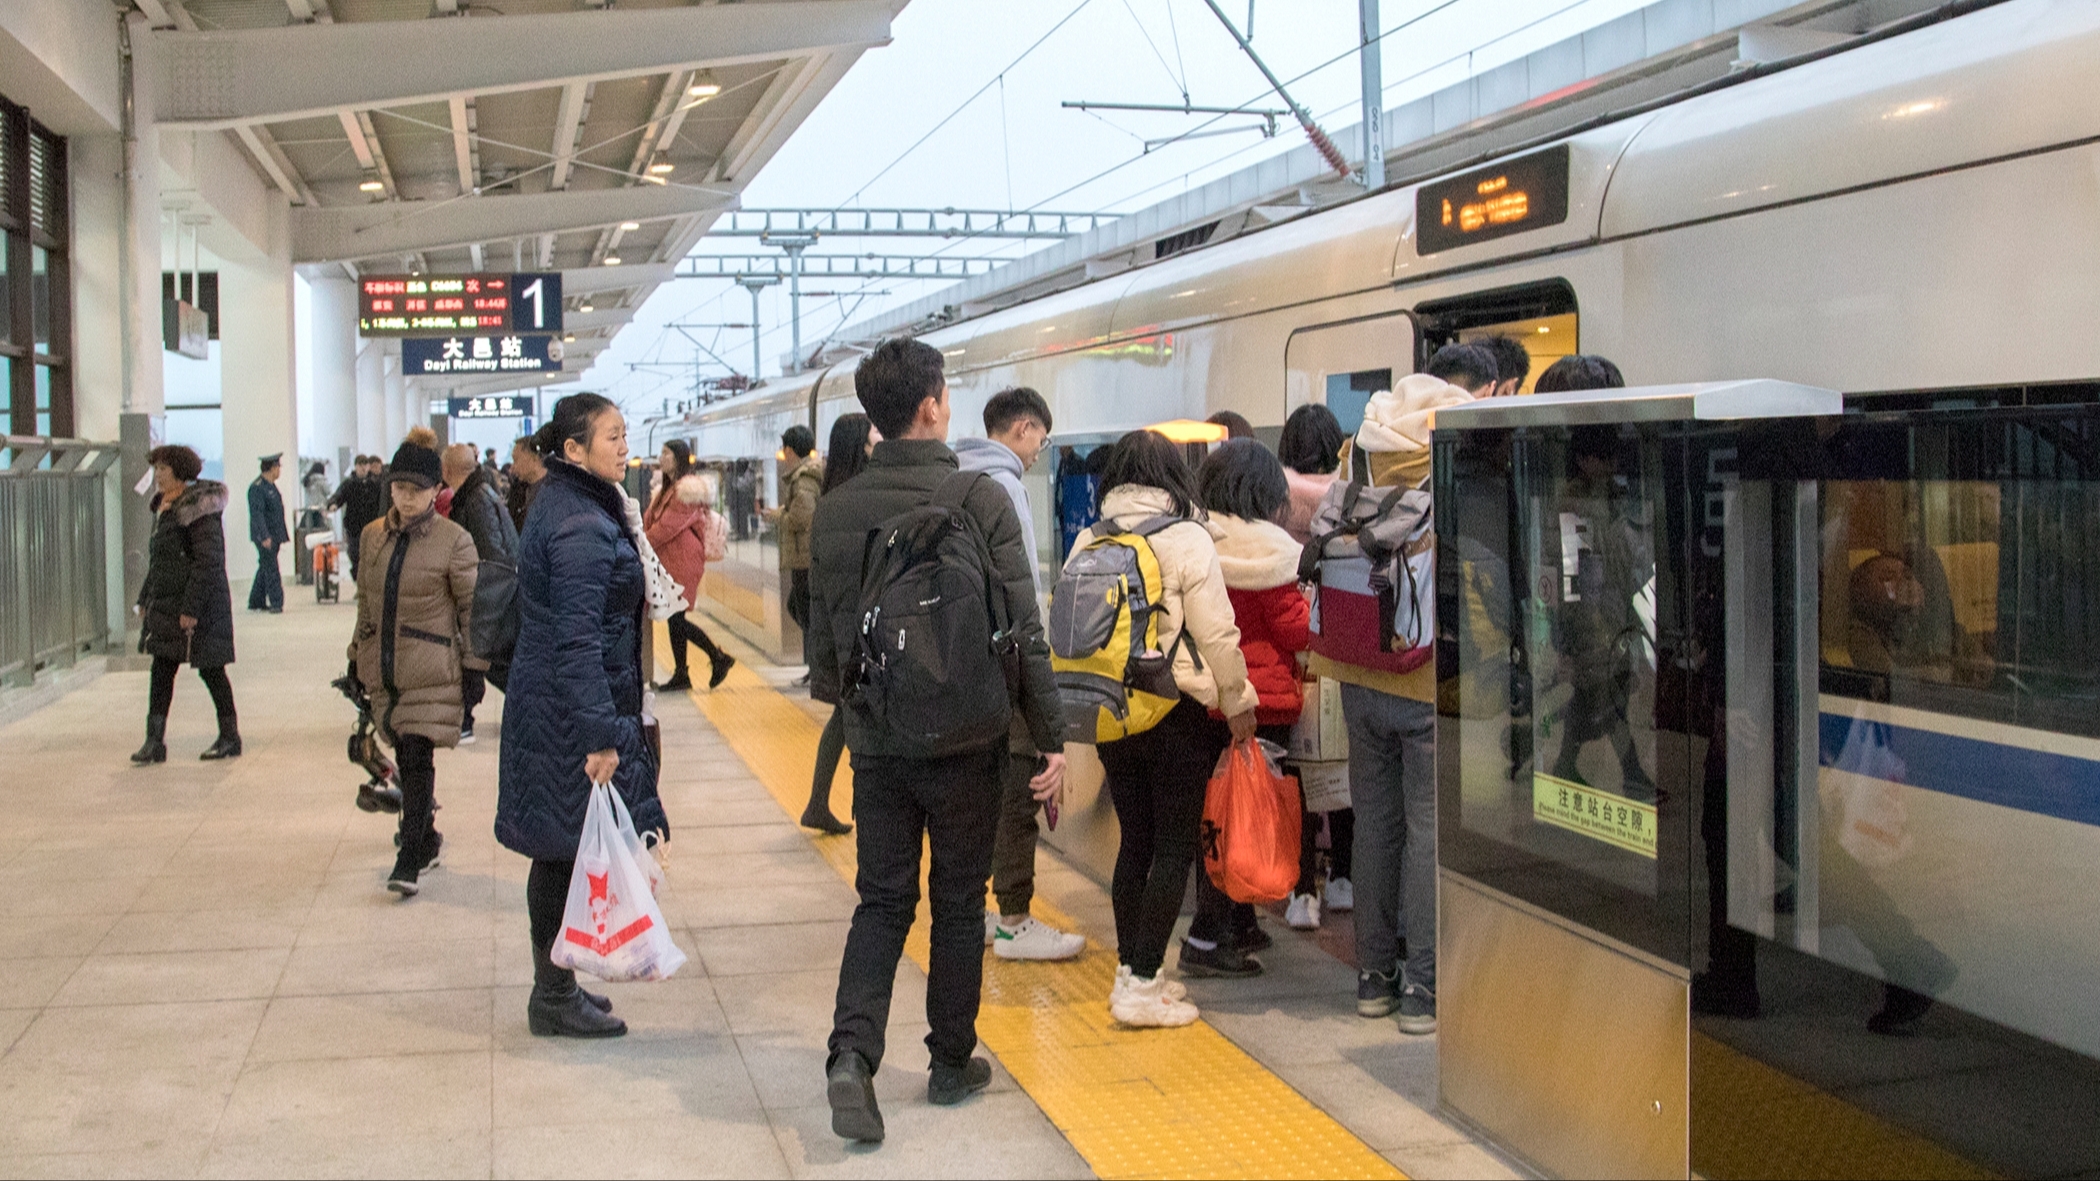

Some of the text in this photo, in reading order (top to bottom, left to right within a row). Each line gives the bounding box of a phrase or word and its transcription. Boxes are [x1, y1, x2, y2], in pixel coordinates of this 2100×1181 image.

[522, 278, 544, 329] 1
[424, 357, 542, 372] Dayi Railway Station
[442, 336, 522, 359] 大邑站
[1538, 800, 1654, 847] Please mind the gap between the train and
